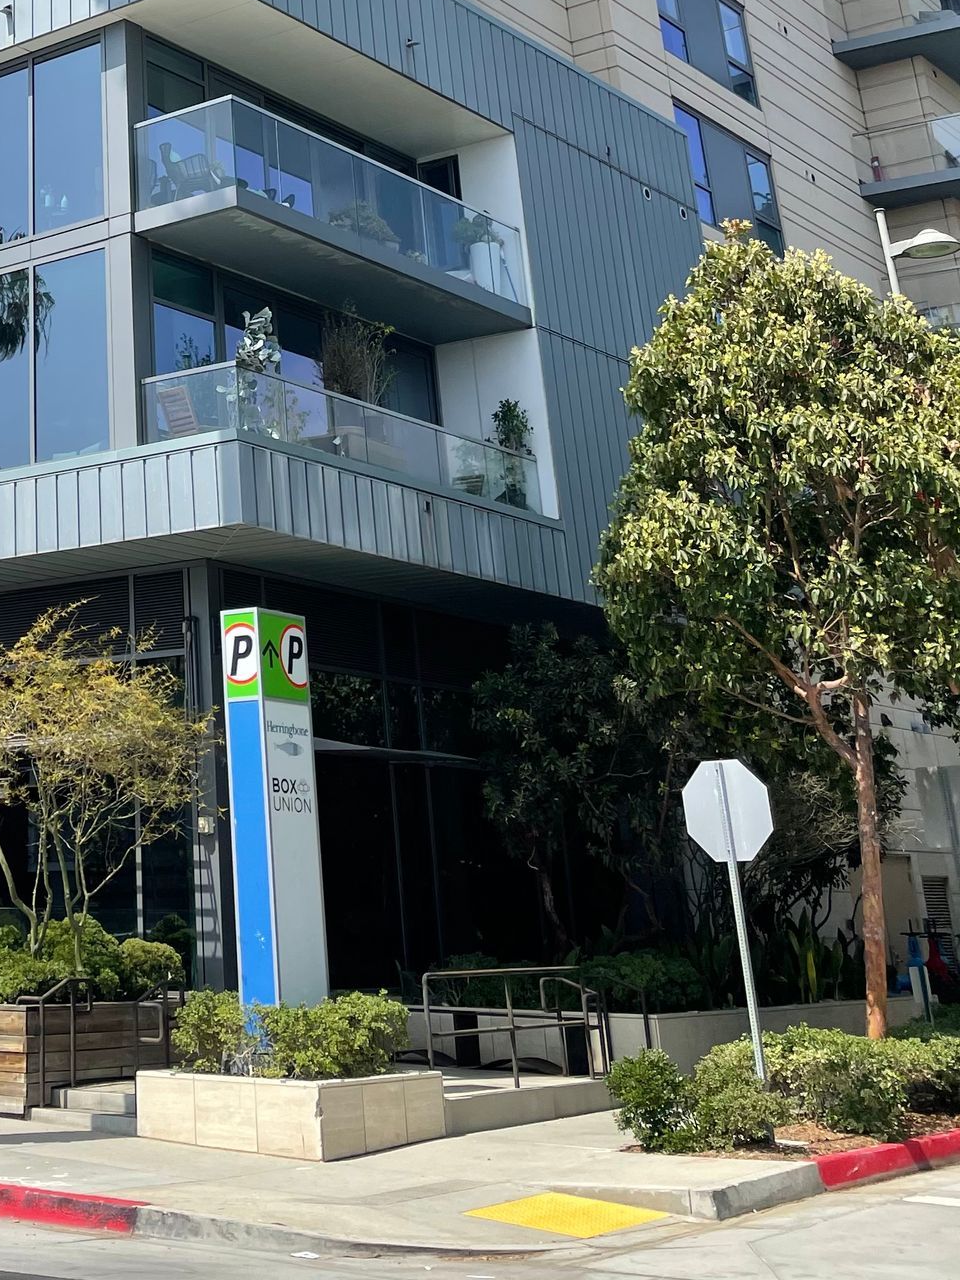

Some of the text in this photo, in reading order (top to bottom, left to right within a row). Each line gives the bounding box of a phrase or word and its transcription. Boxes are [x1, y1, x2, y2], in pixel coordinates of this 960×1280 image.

[230, 634, 253, 677] P
[287, 635, 304, 675] P
[266, 720, 309, 738] Herringbone
[272, 777, 298, 795] BOX
[272, 796, 312, 814] UNION
